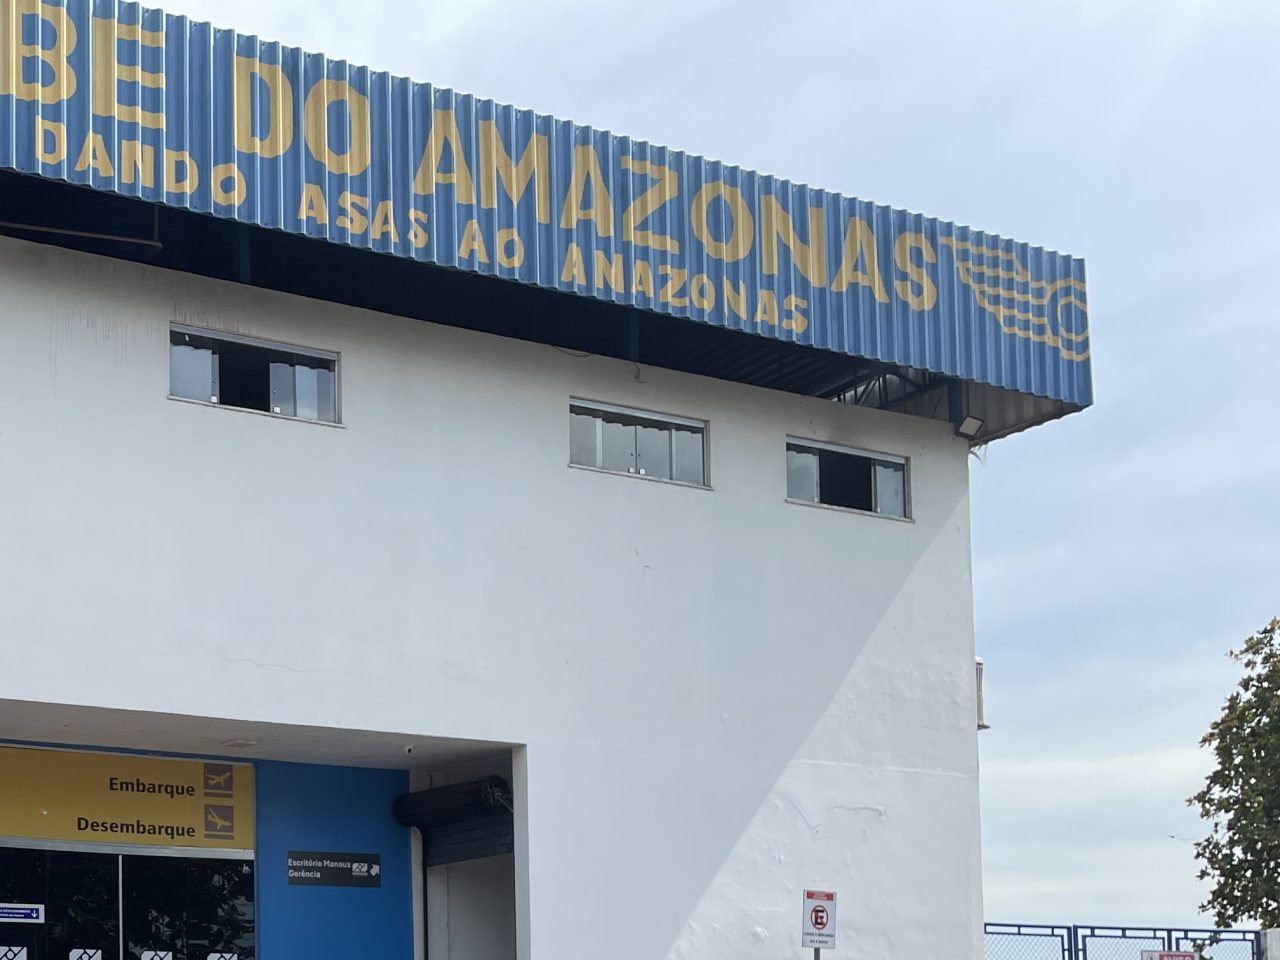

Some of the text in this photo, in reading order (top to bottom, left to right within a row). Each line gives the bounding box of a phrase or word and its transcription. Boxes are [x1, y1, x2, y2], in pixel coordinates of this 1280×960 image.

[35, 115, 247, 207] DANDO
[298, 183, 429, 248] ASAS
[458, 219, 525, 268] AO
[235, 53, 372, 176] DO
[412, 106, 939, 312] AMAZONAS
[76, 817, 196, 839] Desembarque
[109, 776, 196, 798] Embarque
